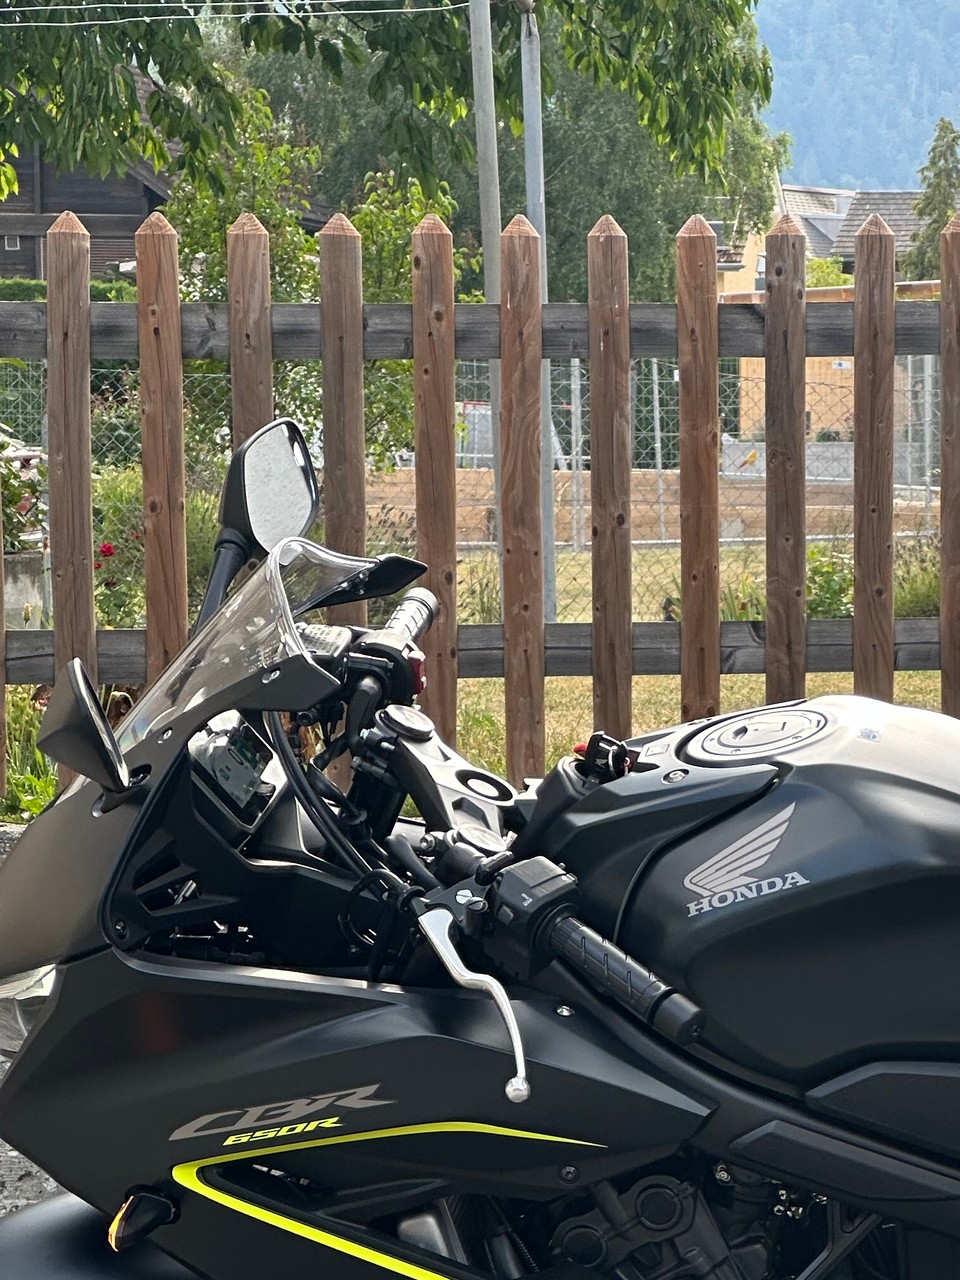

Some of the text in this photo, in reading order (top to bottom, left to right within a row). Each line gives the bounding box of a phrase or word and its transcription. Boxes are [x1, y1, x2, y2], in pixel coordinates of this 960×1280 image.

[686, 871, 810, 917] HONDA
[168, 1083, 395, 1141] CBR
[222, 1116, 346, 1146] 650R
